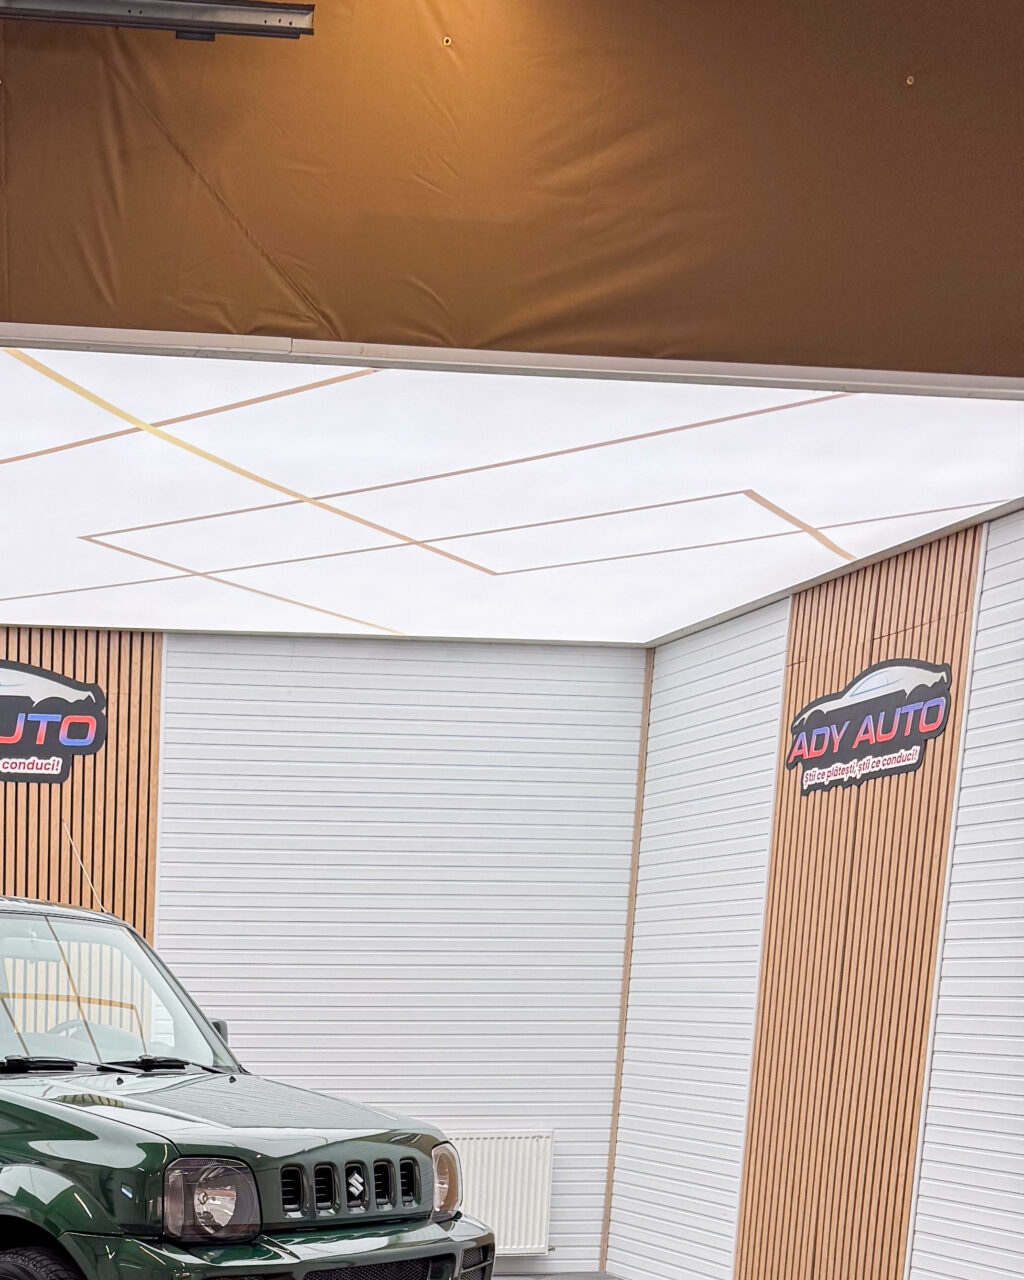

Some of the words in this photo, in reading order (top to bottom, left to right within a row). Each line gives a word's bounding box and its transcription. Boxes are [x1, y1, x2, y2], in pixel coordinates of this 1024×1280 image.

[788, 720, 850, 764] ADY
[852, 697, 946, 749] AUTO
[2, 759, 60, 771] conduci!
[816, 771, 825, 781] ce
[871, 760, 881, 769] ce
[881, 748, 918, 767] conduci!
